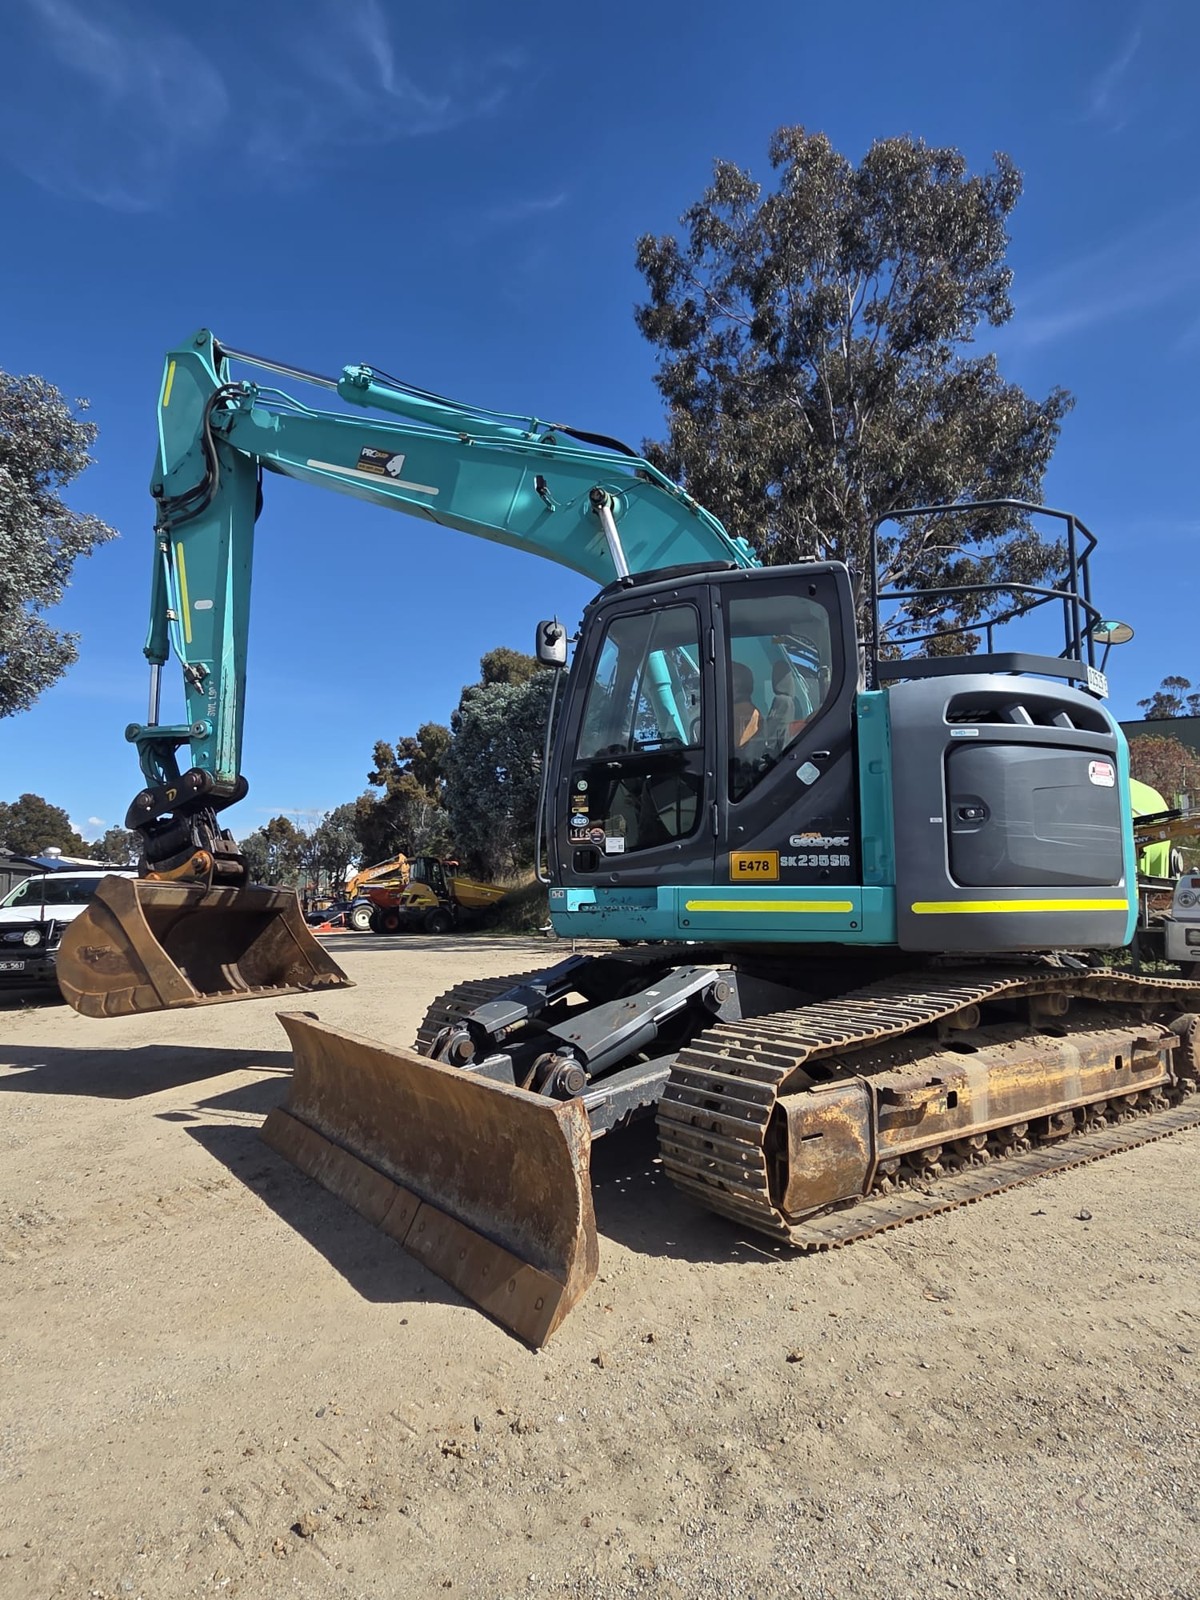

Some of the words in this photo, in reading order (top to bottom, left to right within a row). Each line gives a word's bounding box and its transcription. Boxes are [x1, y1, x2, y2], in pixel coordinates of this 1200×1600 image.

[789, 834, 850, 850] Geospec
[738, 860, 770, 872] E478
[780, 854, 850, 867] SK235SR
